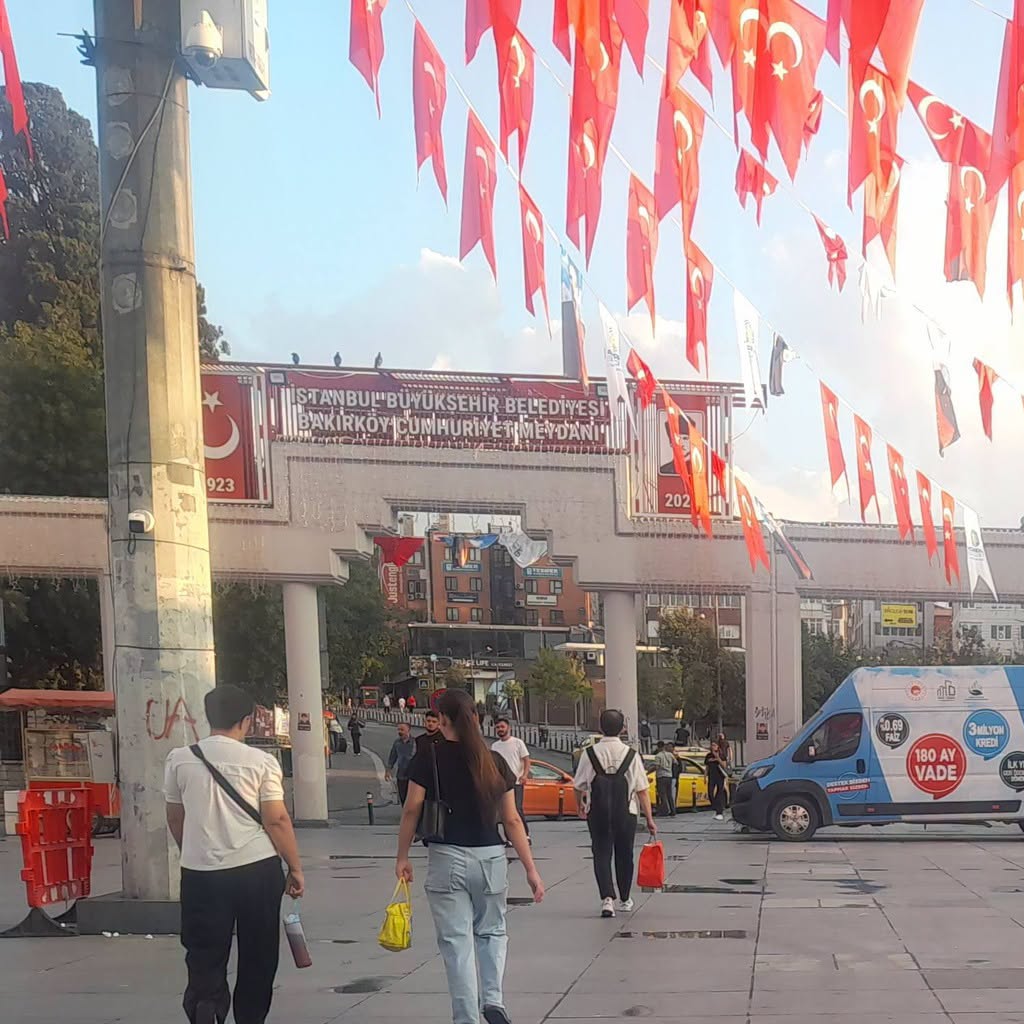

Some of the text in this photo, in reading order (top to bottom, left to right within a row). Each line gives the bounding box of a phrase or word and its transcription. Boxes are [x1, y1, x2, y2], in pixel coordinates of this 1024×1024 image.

[290, 384, 380, 408] İSTANBUL
[505, 395, 605, 417] BELEDİYESİ
[299, 412, 600, 441] BAKIRKÖY CUMHURİYET MEYDANI
[206, 478, 235, 492] 923
[664, 493, 690, 508] 202
[968, 722, 977, 736] 3
[914, 747, 957, 763] 180 AY
[914, 764, 958, 782] VADE
